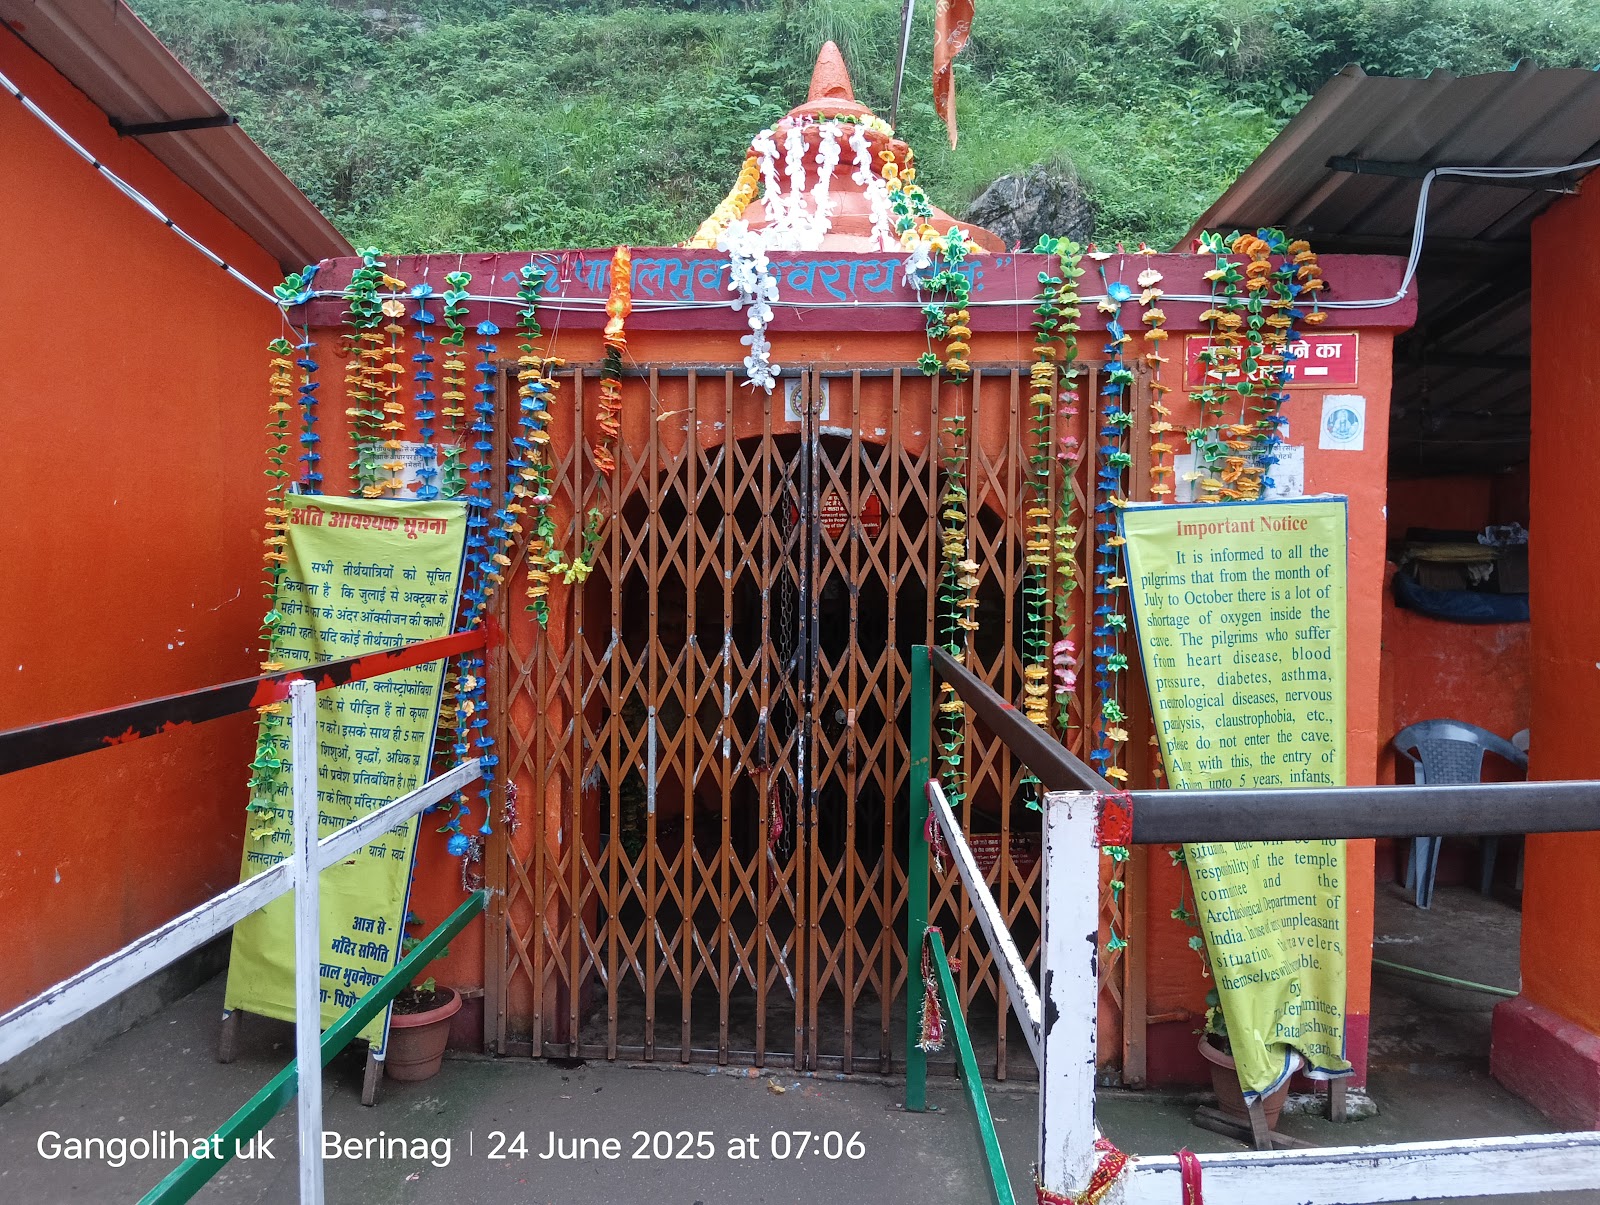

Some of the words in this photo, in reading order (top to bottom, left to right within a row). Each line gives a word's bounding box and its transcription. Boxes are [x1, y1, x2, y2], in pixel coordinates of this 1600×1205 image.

[1316, 343, 1342, 358] का
[290, 505, 325, 526] अति
[328, 512, 399, 531] आवश्यक
[403, 517, 448, 539] सूचना
[1177, 517, 1255, 539] Important
[1260, 516, 1308, 532] Notice
[1176, 551, 1186, 564] It
[1193, 550, 1203, 563] is
[1211, 547, 1264, 562] informed
[1271, 547, 1282, 559] to
[1288, 546, 1302, 558] all
[1310, 544, 1329, 557] the
[312, 560, 334, 574] सभी
[343, 562, 394, 578] तीर्थयात्रियों
[403, 566, 417, 580] को
[426, 568, 452, 586] सूचित
[1141, 570, 1186, 589] pilgrims
[1191, 570, 1214, 584] that
[1219, 569, 1247, 582] from
[1252, 567, 1270, 580] the
[1275, 566, 1310, 580] month
[1316, 564, 1331, 578] of
[323, 582, 331, 598] है
[341, 584, 355, 598] कि
[359, 586, 386, 604] जुलाई
[390, 588, 399, 602] से
[404, 592, 437, 608] अक्टूबर
[439, 590, 449, 605] के
[1144, 593, 1163, 609] July
[1168, 593, 1179, 605] to
[1185, 590, 1233, 604] October
[1238, 588, 1266, 601] there
[1272, 587, 1280, 600] is
[1285, 589, 1290, 599] a
[1295, 587, 1310, 599] lot
[1316, 585, 1331, 598] of
[281, 600, 303, 615] महीने
[322, 605, 334, 619] के
[336, 607, 359, 623] अंदर
[360, 609, 407, 625] ऑक्सीजन
[409, 612, 422, 626] की
[423, 613, 445, 627] काफी
[1147, 613, 1190, 628] shortage
[1199, 611, 1212, 624] of
[1221, 611, 1261, 626] oxygen
[1270, 607, 1301, 621] inside
[1311, 606, 1330, 619] the
[278, 622, 297, 636] कमी
[320, 628, 338, 644] यदि
[340, 629, 361, 647] कोई
[1150, 636, 1172, 647] cave.
[1180, 633, 1203, 646] The
[1211, 630, 1258, 648] pilgrims
[1266, 628, 1288, 641] who
[1295, 626, 1331, 640] suffer
[1153, 654, 1176, 668] from
[1187, 652, 1222, 666] heart
[1233, 650, 1282, 664] disease,
[1292, 647, 1331, 660] blood
[1217, 672, 1271, 686] diabetes,
[1282, 668, 1332, 682] asthma,
[318, 696, 333, 713] आदि
[336, 698, 345, 712] से
[350, 699, 380, 718] पीड़ित
[384, 701, 392, 718] हैं
[396, 703, 406, 717] तो
[1232, 692, 1278, 706] diseases,
[1285, 690, 1332, 703] nervous
[1215, 709, 1295, 728] claustrophobia,
[1307, 710, 1333, 724] etc.,
[320, 722, 325, 732] न
[342, 723, 367, 739] इसके
[370, 727, 391, 739] साथ
[393, 726, 402, 742] ही
[404, 731, 409, 741] 5
[1196, 736, 1210, 749] do
[1219, 735, 1237, 748] not
[1244, 733, 1270, 746] enter
[1277, 730, 1292, 743] the
[1301, 731, 1333, 742] cave.
[280, 736, 290, 750] के
[355, 747, 381, 764] वृद्धों,
[386, 749, 411, 765] अधिक
[1198, 756, 1222, 770] with
[1231, 754, 1252, 768] this,
[1260, 752, 1275, 764] the
[1282, 751, 1312, 764] entry
[1322, 750, 1335, 762] of
[319, 765, 328, 779] भी
[330, 767, 350, 783] प्रवेश
[353, 770, 396, 787] प्रतिबंधित
[1239, 774, 1246, 787] 5
[1253, 772, 1282, 786] years,
[1290, 769, 1334, 786] infants,
[326, 789, 335, 803] के
[336, 790, 352, 810] लिए
[354, 793, 378, 810] मंदिर
[369, 844, 386, 858] यात्री
[392, 847, 406, 861] स्वयं
[1252, 854, 1260, 869] of
[1268, 853, 1284, 866] the
[1295, 853, 1337, 869] temple
[1263, 873, 1280, 888] and
[1318, 873, 1338, 888] the
[1327, 896, 1341, 909] of
[377, 916, 386, 935] से
[1210, 929, 1246, 945] India.
[1281, 912, 1339, 930] unpleasant
[358, 942, 389, 962] समिति
[320, 963, 342, 980] ताल
[343, 967, 384, 987] भुवनेश्व
[1222, 969, 1280, 990] themselves
